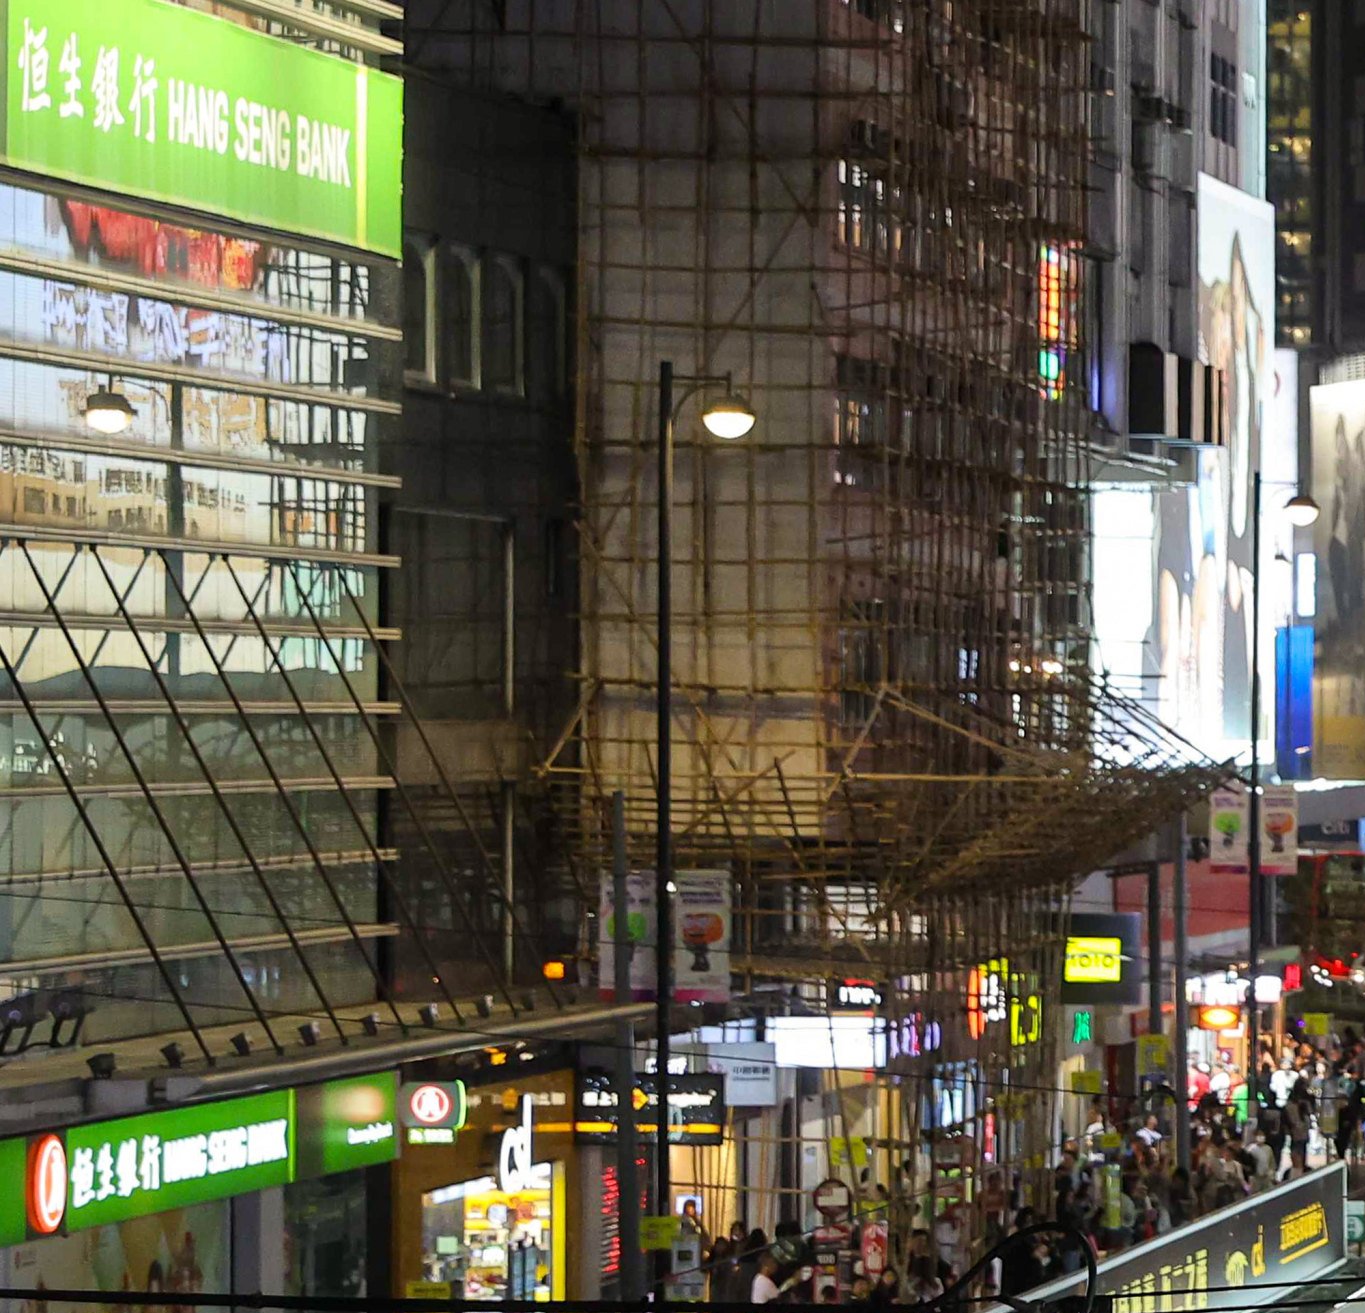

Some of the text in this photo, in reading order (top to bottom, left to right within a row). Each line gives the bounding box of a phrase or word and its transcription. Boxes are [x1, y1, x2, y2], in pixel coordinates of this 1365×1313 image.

[19, 17, 156, 144] 恒生銀行
[167, 79, 352, 188] HANG SENG BANK
